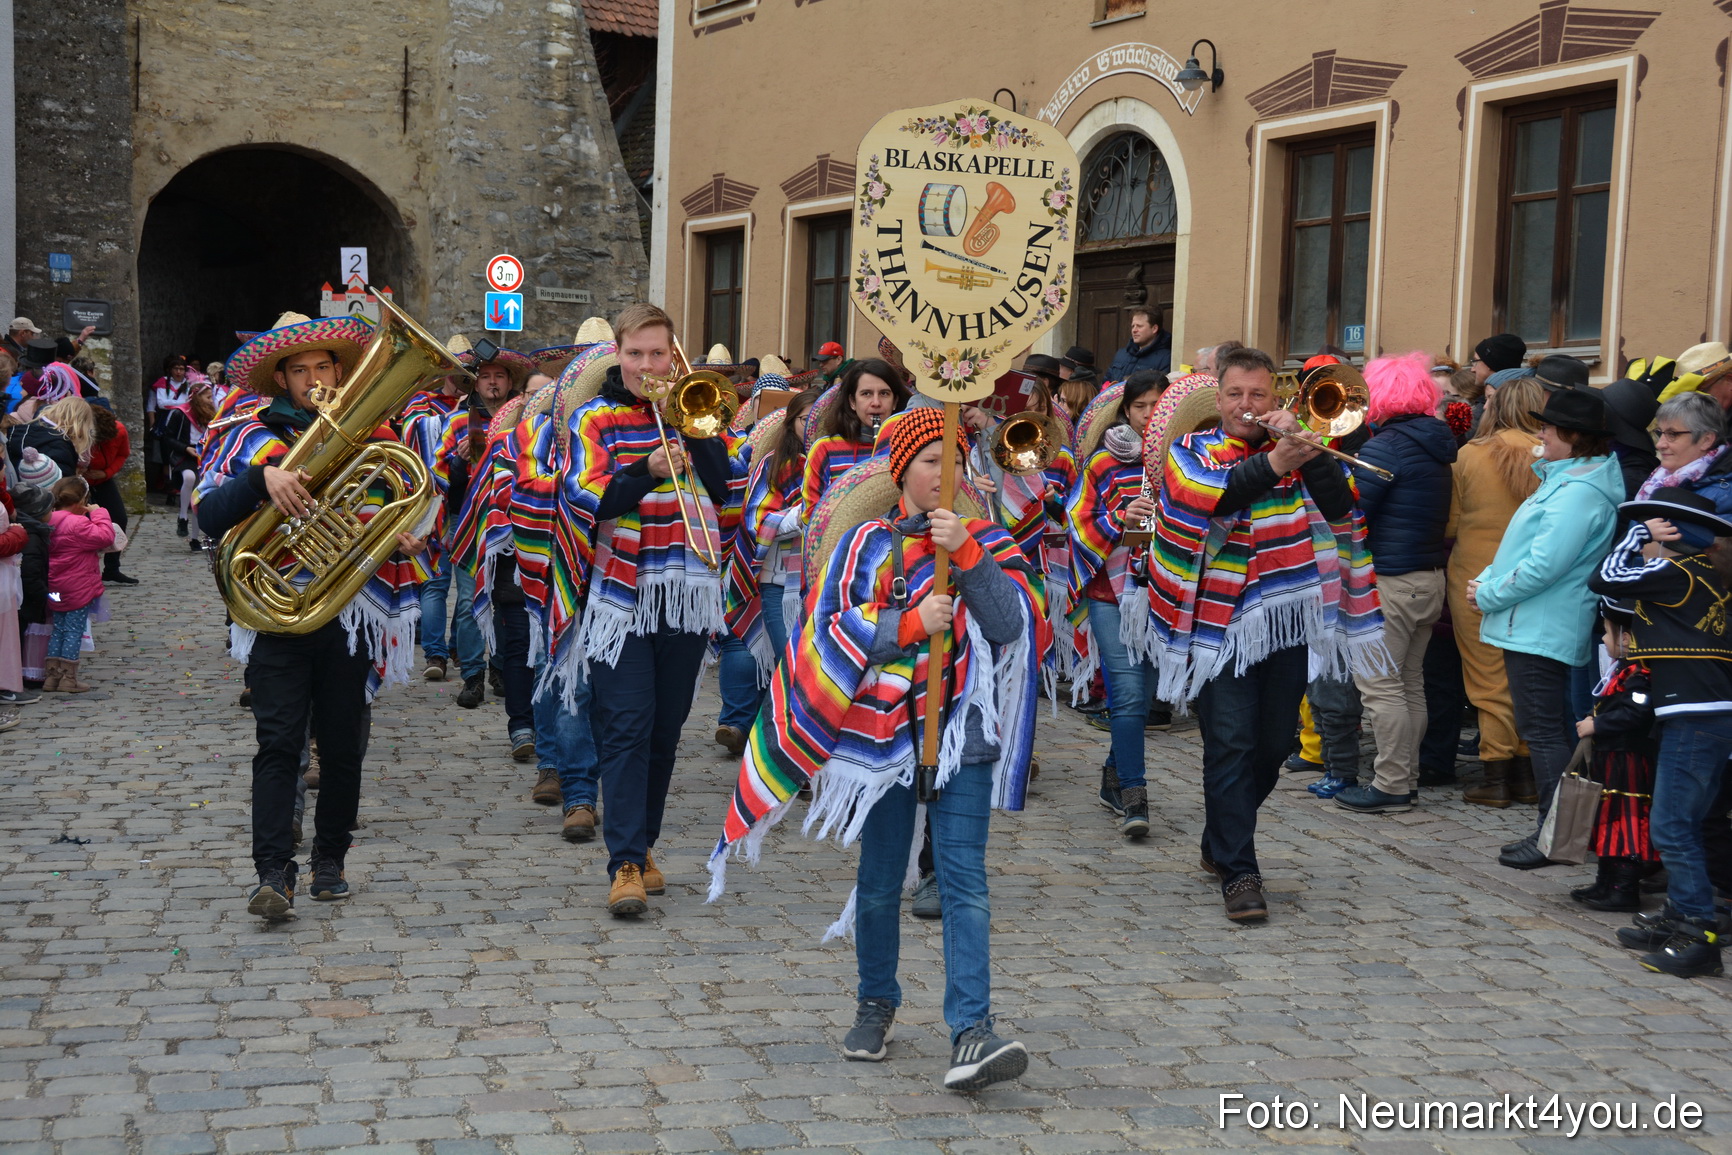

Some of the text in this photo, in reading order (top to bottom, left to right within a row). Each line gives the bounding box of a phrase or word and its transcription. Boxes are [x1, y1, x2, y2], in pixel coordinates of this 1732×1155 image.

[1045, 66, 1090, 122] Bistro
[884, 147, 1055, 180] BLASKAPELLE
[349, 253, 362, 274] 2
[496, 265, 504, 281] 3
[876, 218, 1054, 342] THANNHAUSEN
[540, 289, 588, 302] Ringmauerweg
[1348, 327, 1361, 340] 16
